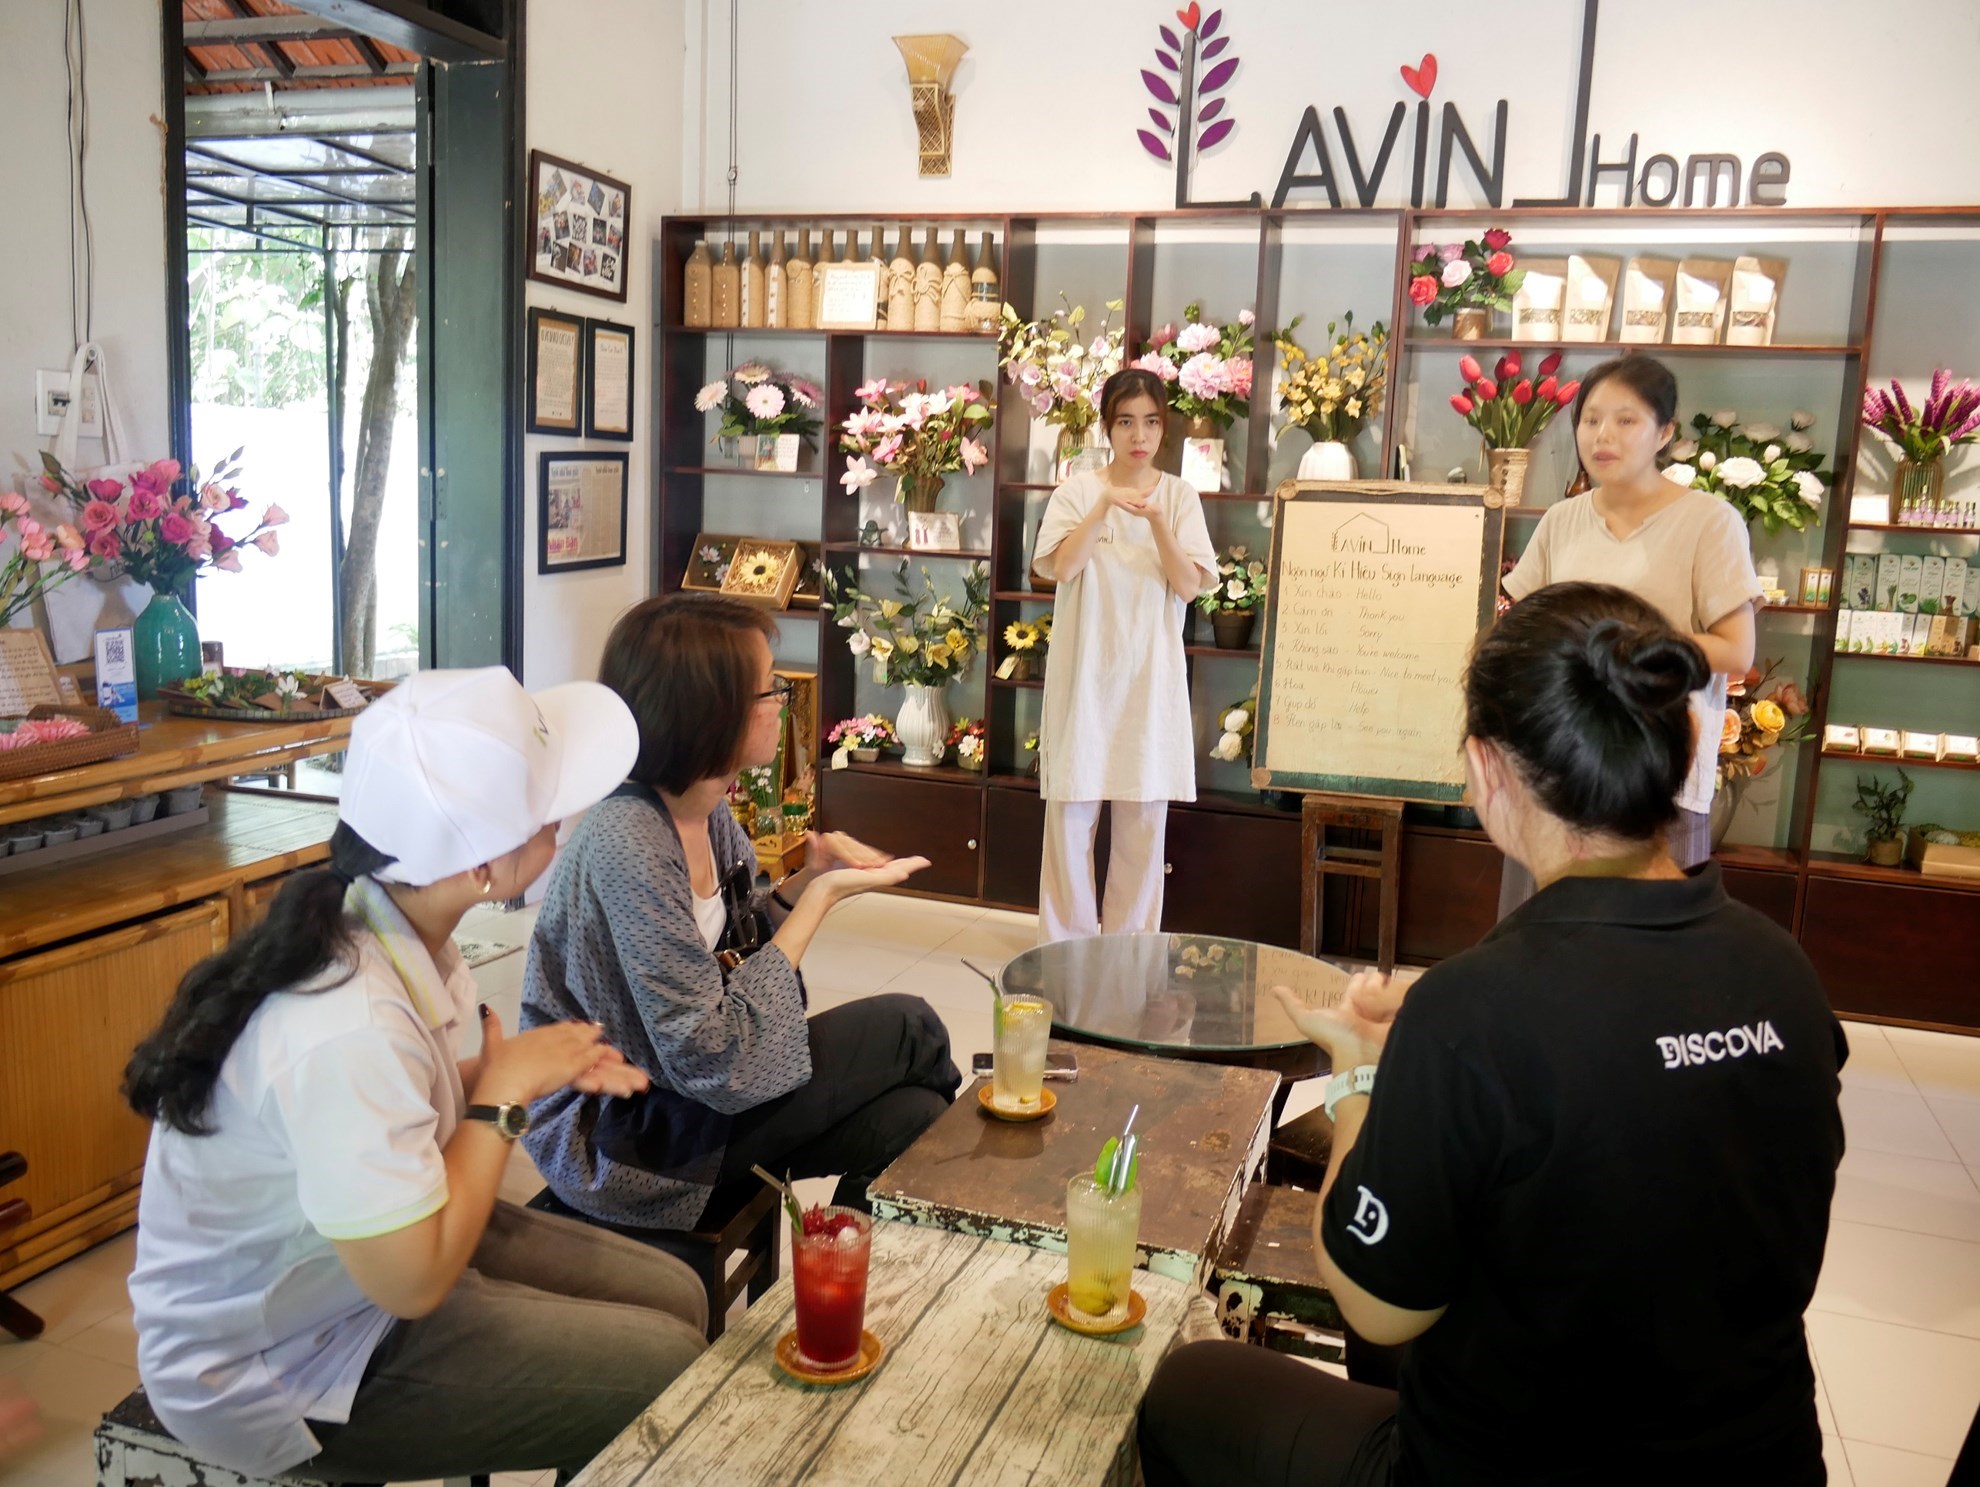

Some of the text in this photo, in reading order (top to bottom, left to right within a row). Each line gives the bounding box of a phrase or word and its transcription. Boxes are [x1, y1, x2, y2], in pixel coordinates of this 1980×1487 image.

[1587, 133, 1791, 208] Home
[1391, 538, 1427, 556] Home
[1382, 562, 1406, 588] Sign
[1410, 564, 1464, 589] Language
[1294, 584, 1312, 598] Xin
[1356, 587, 1382, 601] Hello
[1387, 613, 1405, 625] you
[1293, 621, 1310, 634] Xin
[1359, 624, 1383, 643] Sorry
[1382, 647, 1420, 661] welcome
[1380, 666, 1400, 679] Nice
[1403, 666, 1413, 680] to
[1414, 668, 1437, 681] meet
[1350, 680, 1379, 696] Flower
[1349, 700, 1370, 717] Help
[1655, 1020, 1785, 1070] DISCOVA
